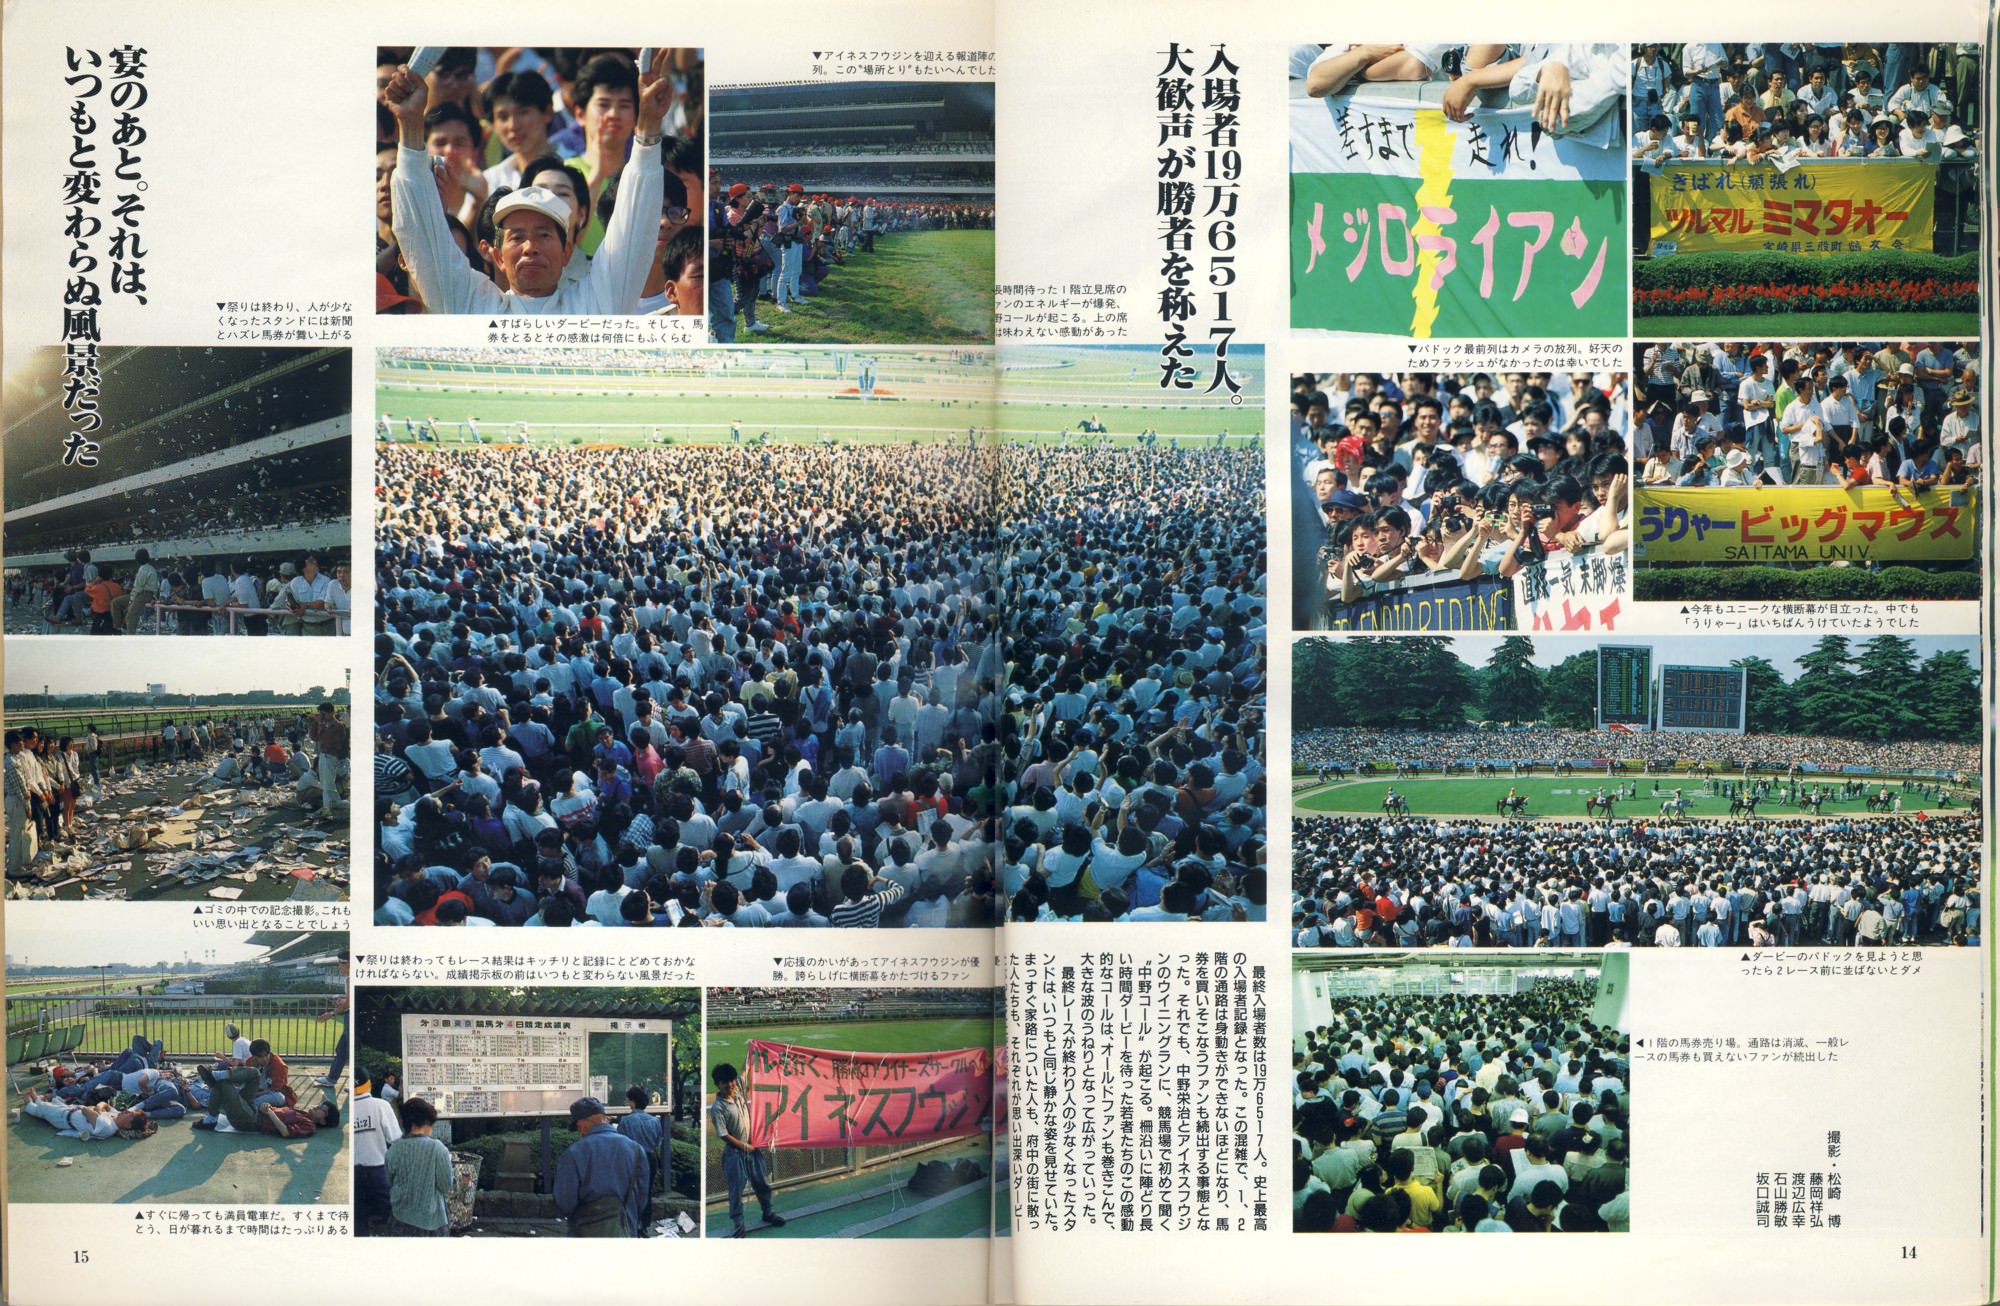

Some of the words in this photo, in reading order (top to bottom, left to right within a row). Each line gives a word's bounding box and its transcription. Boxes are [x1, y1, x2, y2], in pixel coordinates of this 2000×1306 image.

[1336, 106, 1415, 161] 差すまで
[108, 44, 148, 305] 宴のあと。それは、
[1154, 42, 1197, 389] 大歓声が勝者を称えた
[1200, 42, 1243, 406] 入場者19万6517人。
[1763, 199, 1909, 237] ミマタオー
[62, 44, 103, 467] いつもと変わらぬ風景だった
[1304, 202, 1608, 310] メジロライアン
[1638, 506, 1736, 542] うりゃー
[1741, 505, 1962, 543] ビッグマウス
[1725, 545, 1809, 560] SAITAMA
[1819, 545, 1874, 560] UNIV.
[1756, 1172, 1770, 1228] 坂口誠司
[1774, 1173, 1788, 1228] 石山勝敏
[1792, 1172, 1805, 1228] 渡辺広幸
[1810, 1173, 1823, 1228] 藤岡祥弘
[1828, 1214, 1841, 1228] 博
[74, 1251, 89, 1263] 15
[1902, 1246, 1917, 1259] 14
